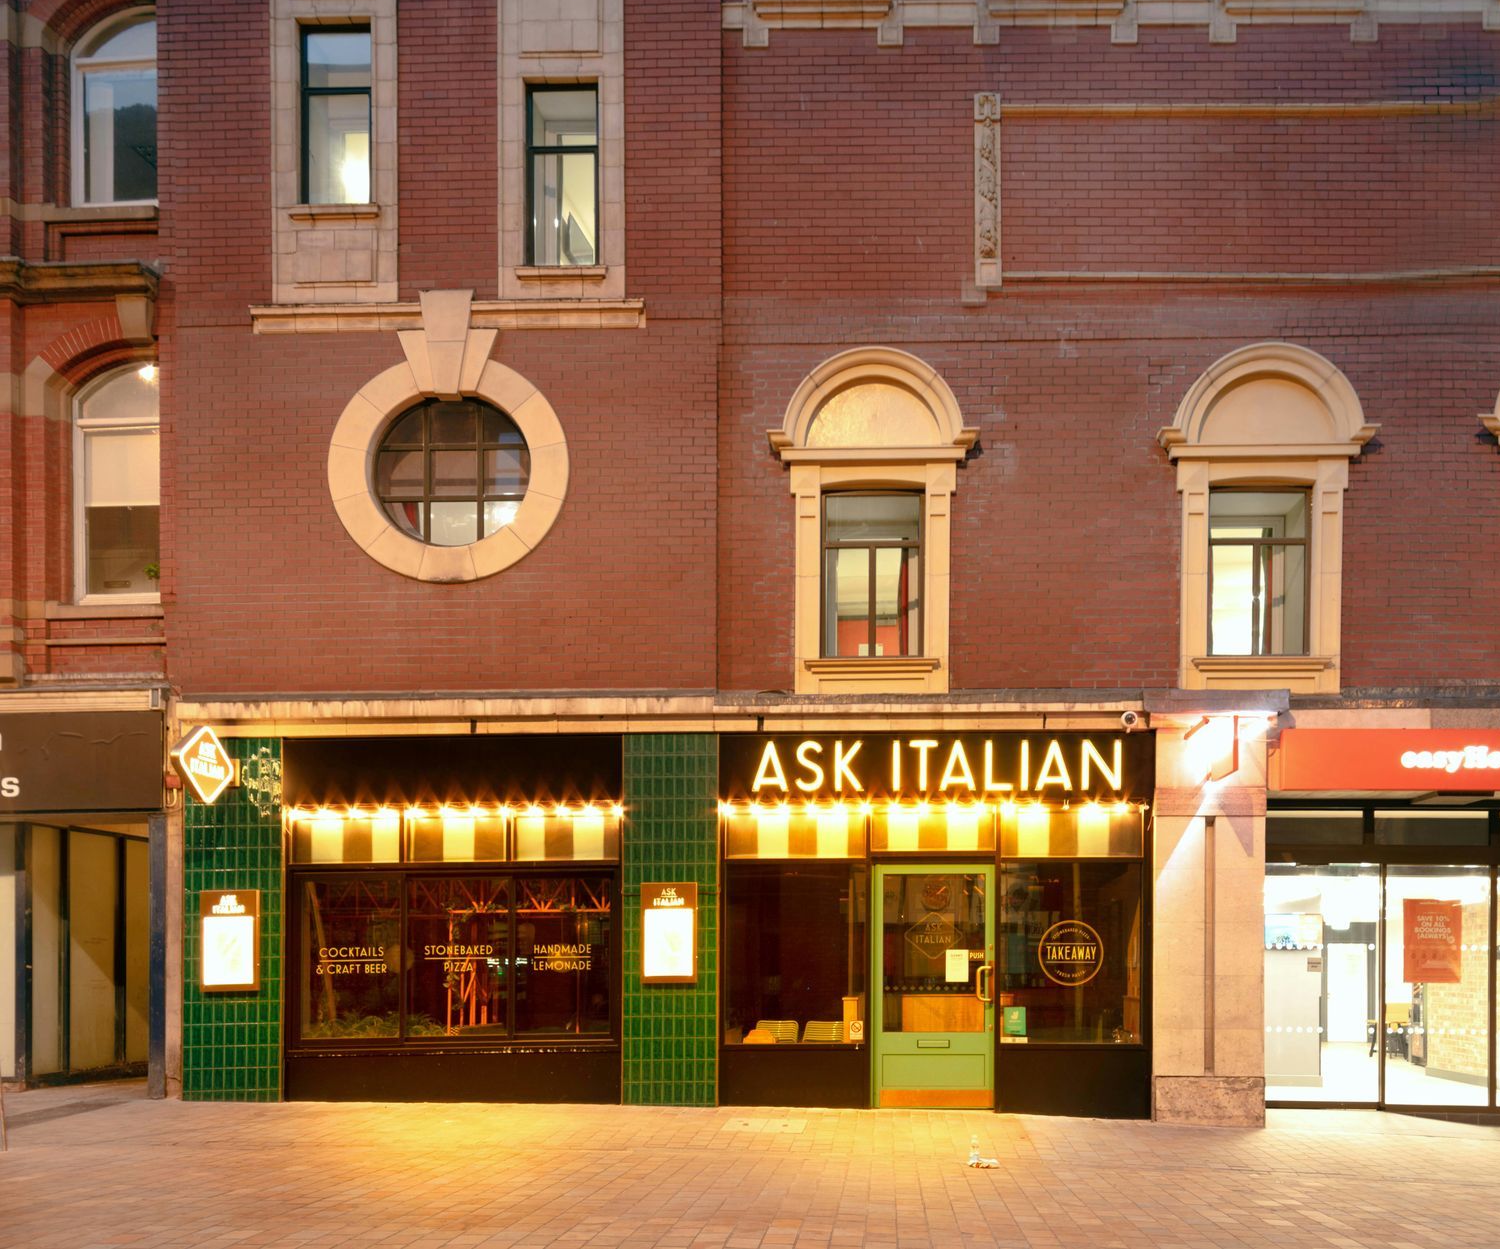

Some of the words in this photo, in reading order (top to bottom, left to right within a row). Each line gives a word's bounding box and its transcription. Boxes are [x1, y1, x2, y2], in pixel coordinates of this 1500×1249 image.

[751, 739, 864, 793] ASK
[892, 739, 1122, 792] ITALIAN
[661, 887, 677, 896] ASK
[653, 897, 685, 907] ITALIAN
[925, 923, 942, 932] ASK
[915, 934, 952, 944] ITALIAN
[319, 947, 384, 958] COCKTAILS
[424, 945, 493, 956] STONEBAKED
[534, 944, 592, 954] HANDMADE
[1046, 945, 1097, 960] TAKEAWAY
[316, 964, 324, 975] &
[326, 964, 361, 975] CRAFT
[364, 963, 388, 974] BEER
[443, 961, 474, 972] PIZZA
[534, 960, 592, 971] LEMONADE
